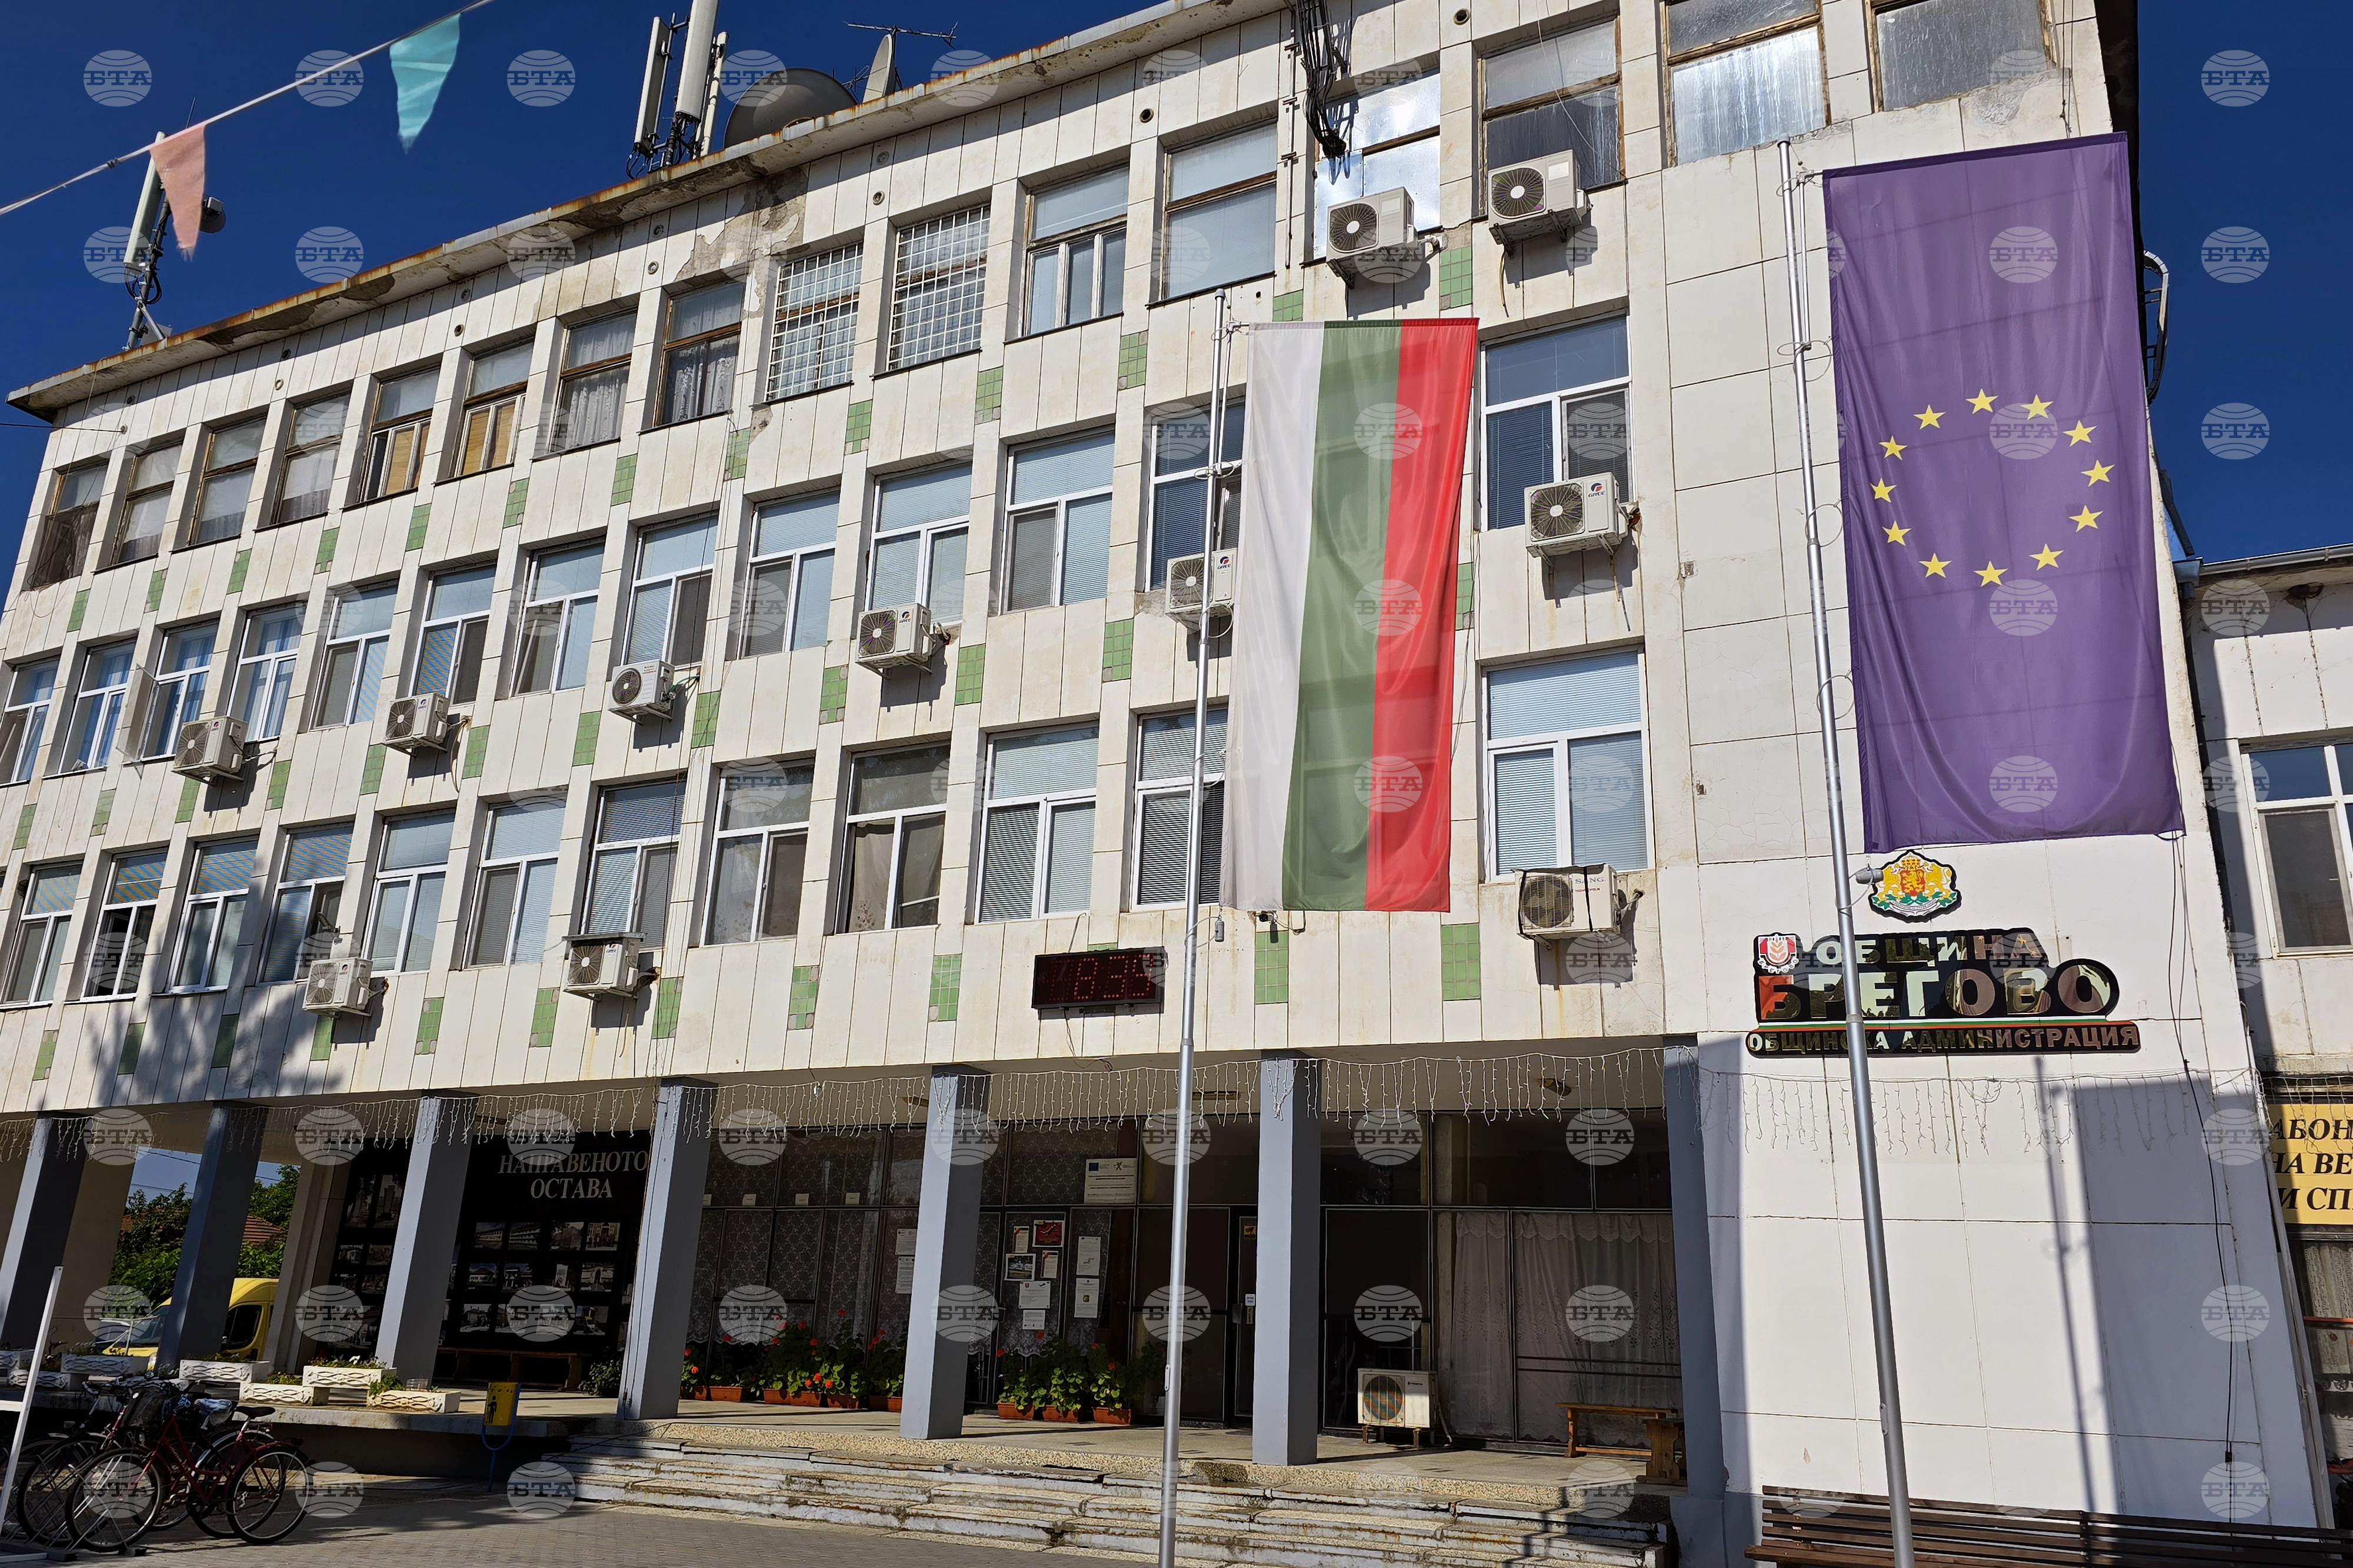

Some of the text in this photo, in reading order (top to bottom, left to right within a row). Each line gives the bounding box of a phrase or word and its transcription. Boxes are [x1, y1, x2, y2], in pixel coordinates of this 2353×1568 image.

[1816, 933, 2042, 967] ОБЩИНА
[1759, 963, 2111, 1020] БРЕГОВО
[1901, 1026, 2139, 1053] АДМИНИСТРАЦИЯ
[498, 1150, 648, 1173] НАПРАВЕНОТО
[531, 1178, 612, 1199] ОСТАВА
